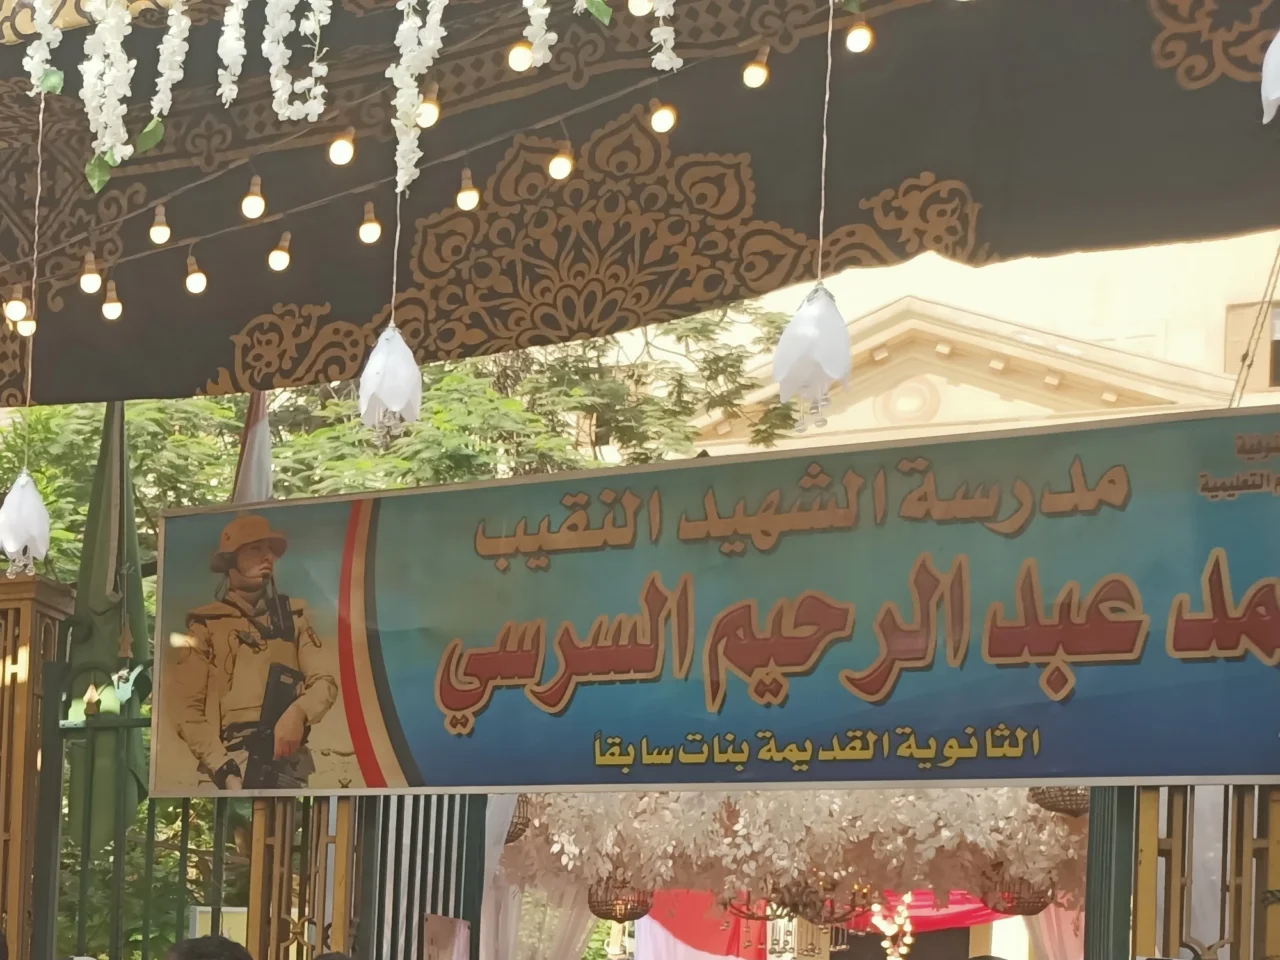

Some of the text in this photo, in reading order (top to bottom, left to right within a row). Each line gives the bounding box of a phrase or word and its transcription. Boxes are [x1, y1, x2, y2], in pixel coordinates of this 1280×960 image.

[474, 454, 1131, 571] مدرسة الشهيد النقيب
[1199, 471, 1271, 500] التعليمية
[435, 571, 696, 737] السرسي
[703, 552, 971, 714] الرحيم
[981, 556, 1150, 702] عبد
[677, 731, 750, 774] بنات
[756, 730, 890, 773] القديمة
[895, 722, 1041, 769] الثانوية
